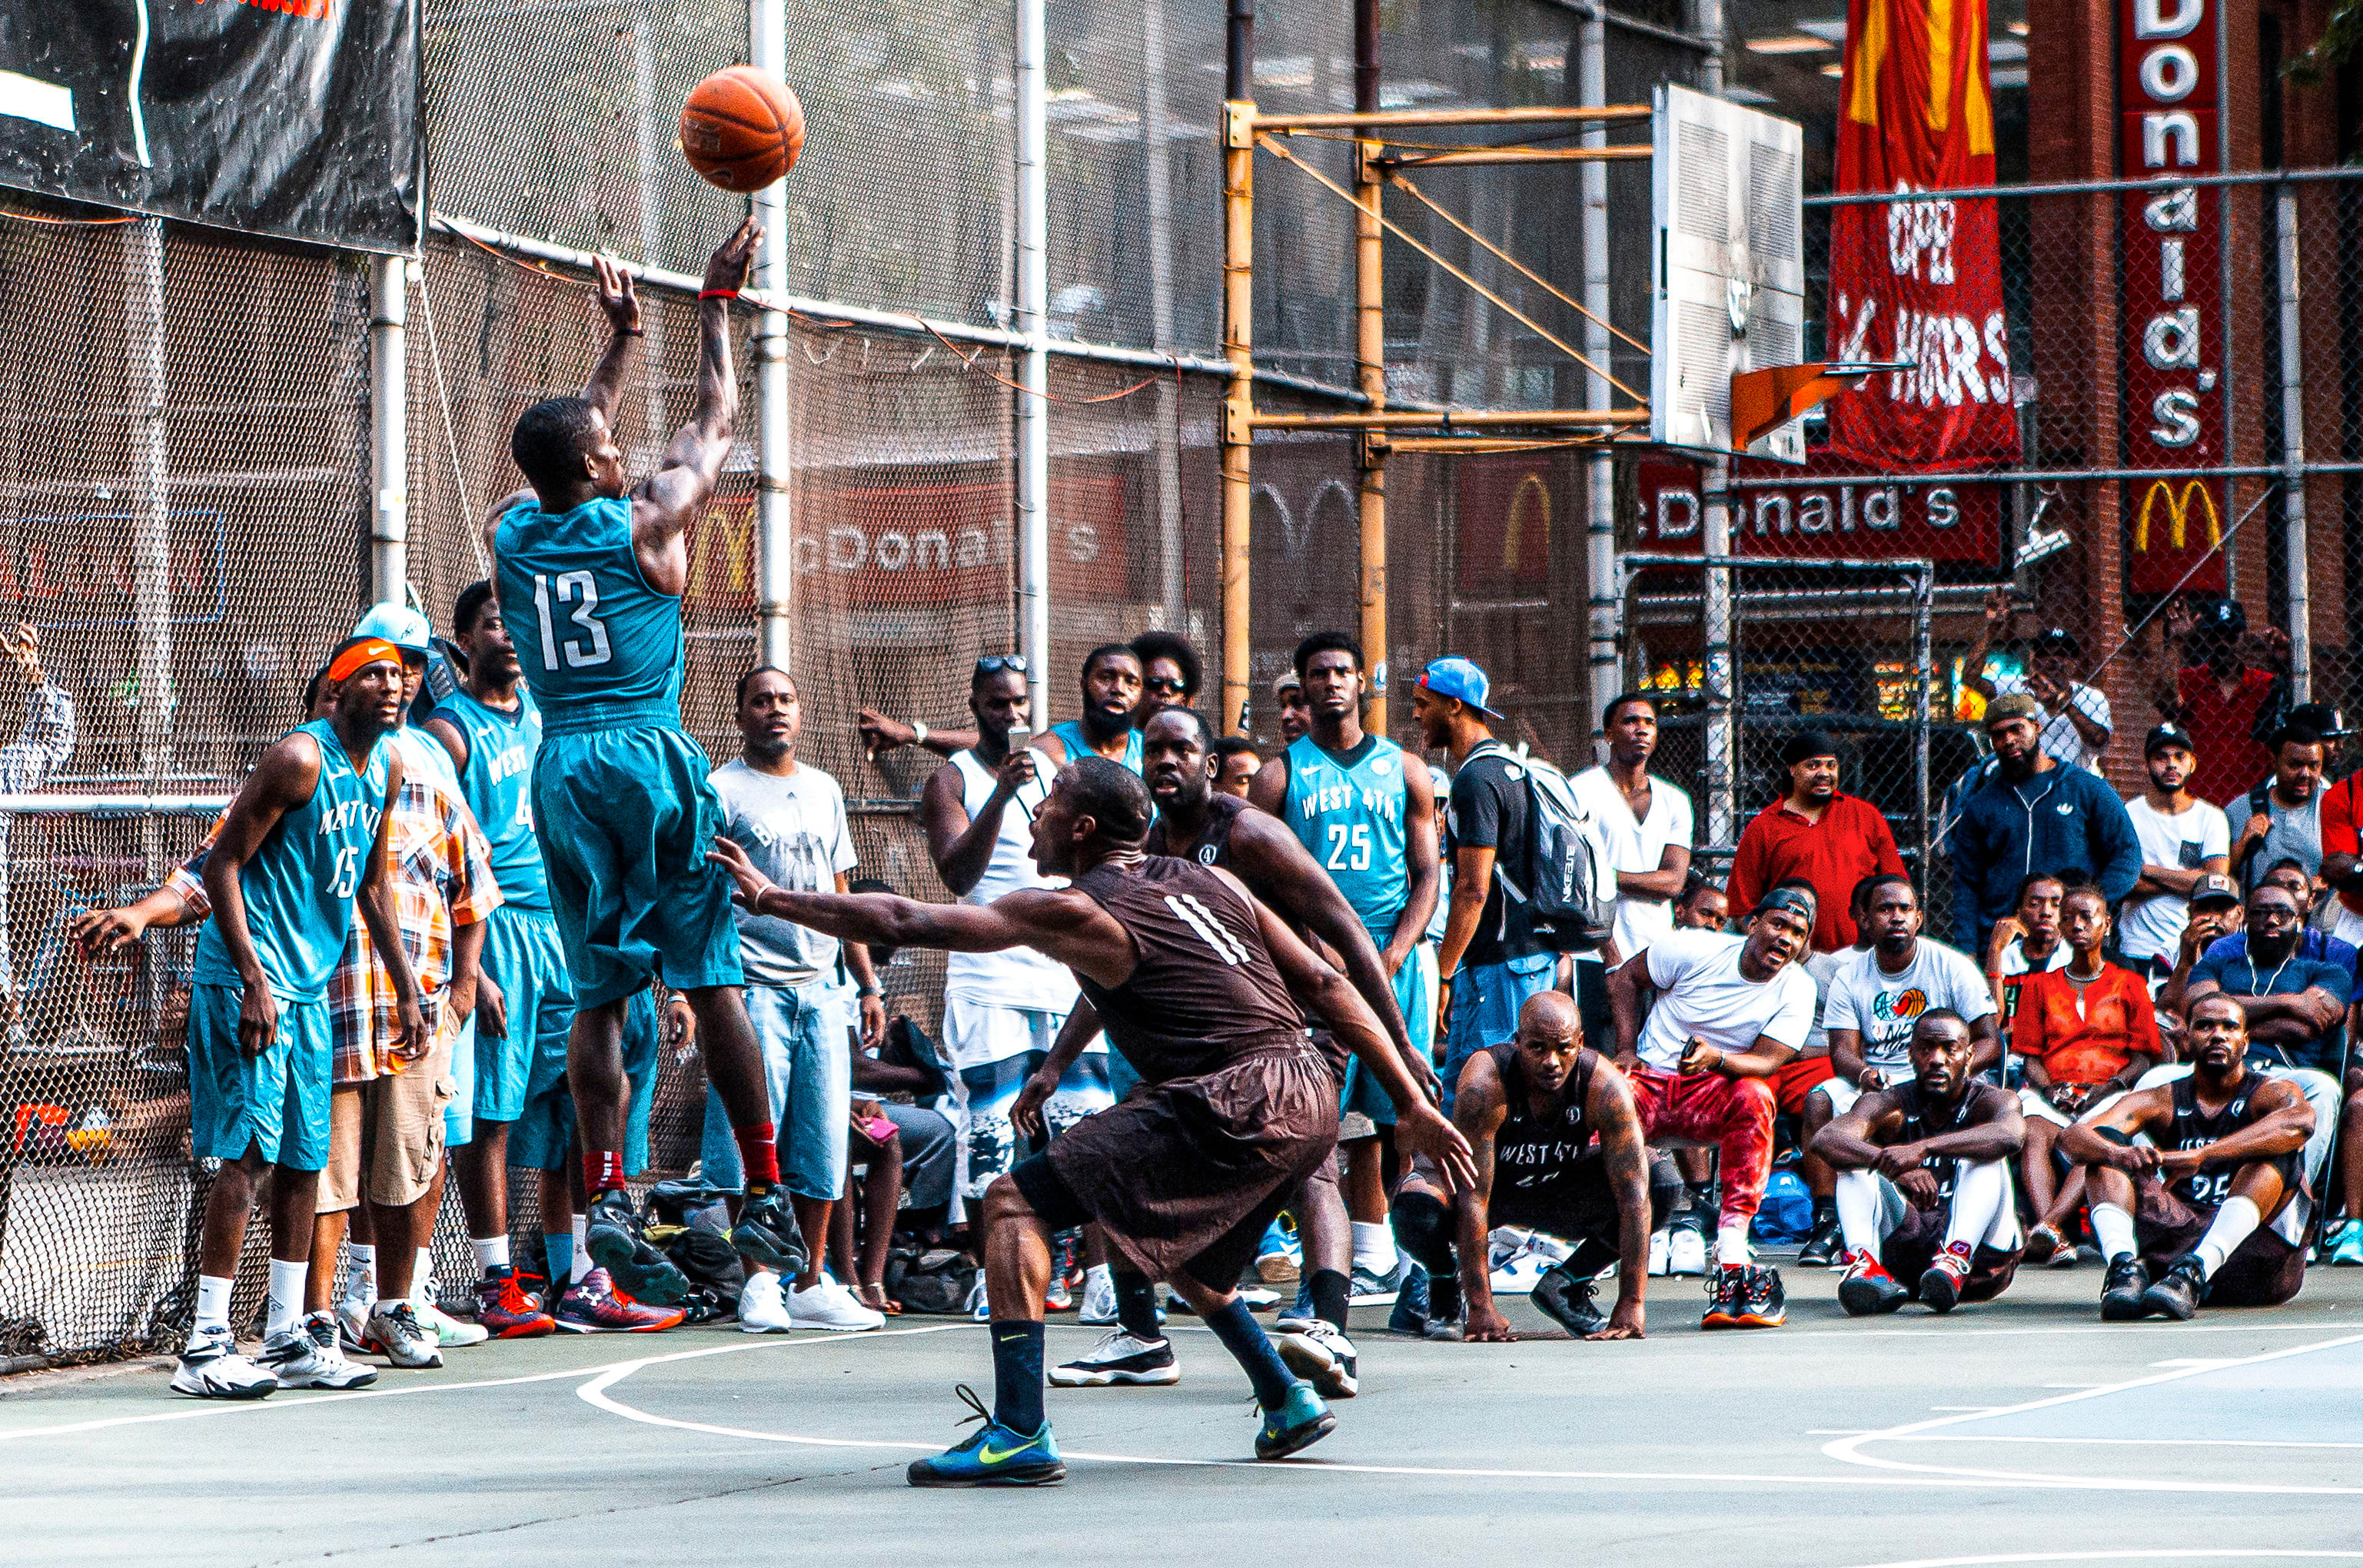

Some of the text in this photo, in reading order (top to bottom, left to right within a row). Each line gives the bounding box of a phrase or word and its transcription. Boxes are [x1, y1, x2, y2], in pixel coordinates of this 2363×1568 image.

[533, 570, 612, 670] 13
[487, 744, 528, 787] WEST
[1301, 784, 1396, 823] WEST 4TH
[1327, 823, 1371, 871] 25
[325, 846, 360, 899] 15
[1163, 893, 1252, 966] 11
[1499, 1143, 1550, 1165] WEST
[2192, 1173, 2231, 1205] 25
